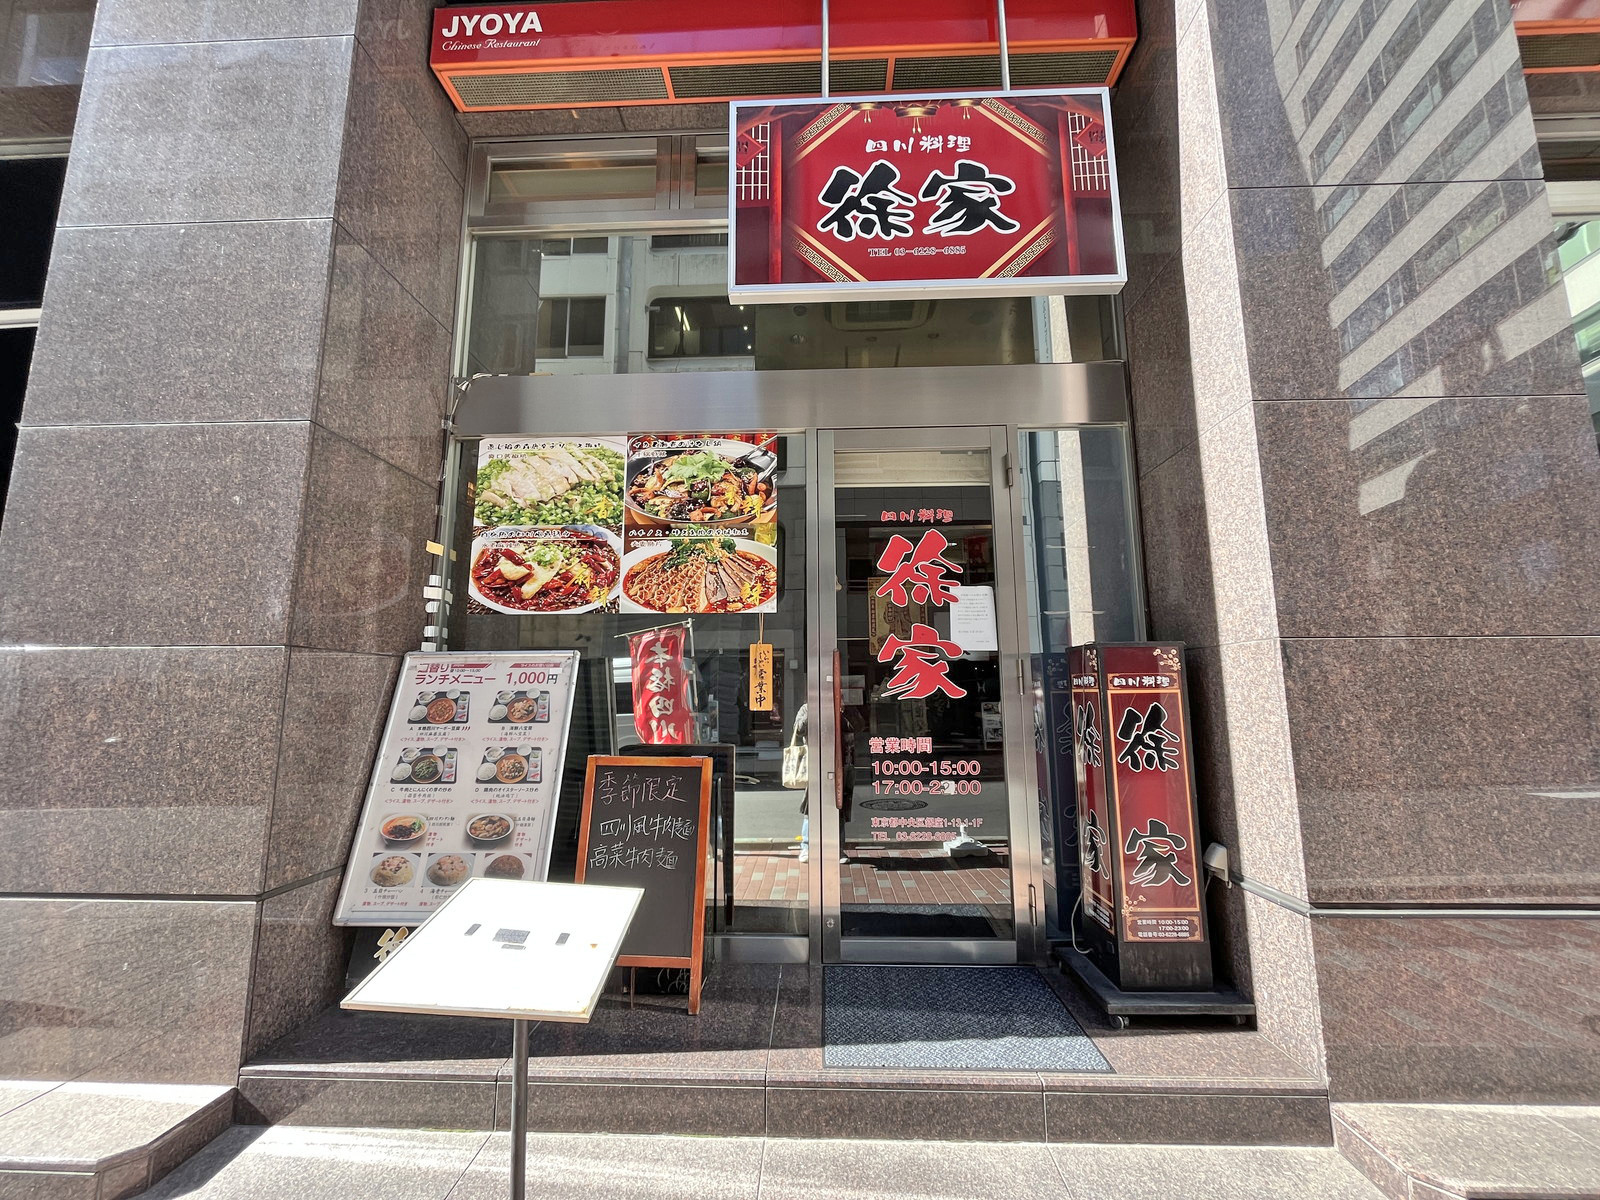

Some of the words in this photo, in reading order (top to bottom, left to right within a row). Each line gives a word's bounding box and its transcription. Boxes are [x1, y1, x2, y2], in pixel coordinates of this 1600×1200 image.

[442, 11, 543, 38] JYOYA
[442, 40, 482, 51] Chinese
[483, 38, 541, 49] Restaurant
[865, 135, 972, 153] 四川料理
[816, 159, 1021, 242] 徐家
[868, 248, 892, 257] TEL
[893, 245, 967, 256] 03-6228-6885
[880, 508, 954, 523] 四川料理
[876, 528, 967, 700] 徐家
[415, 674, 496, 685] ランチメニュー
[506, 671, 559, 686] 1,000円
[1113, 675, 1170, 688] 四川料理
[646, 641, 679, 744] 本格四川
[868, 736, 933, 754] 営業時間
[871, 760, 981, 775] 10:00-15:00
[599, 771, 687, 809] 季節限定
[1117, 702, 1192, 887] 徐家
